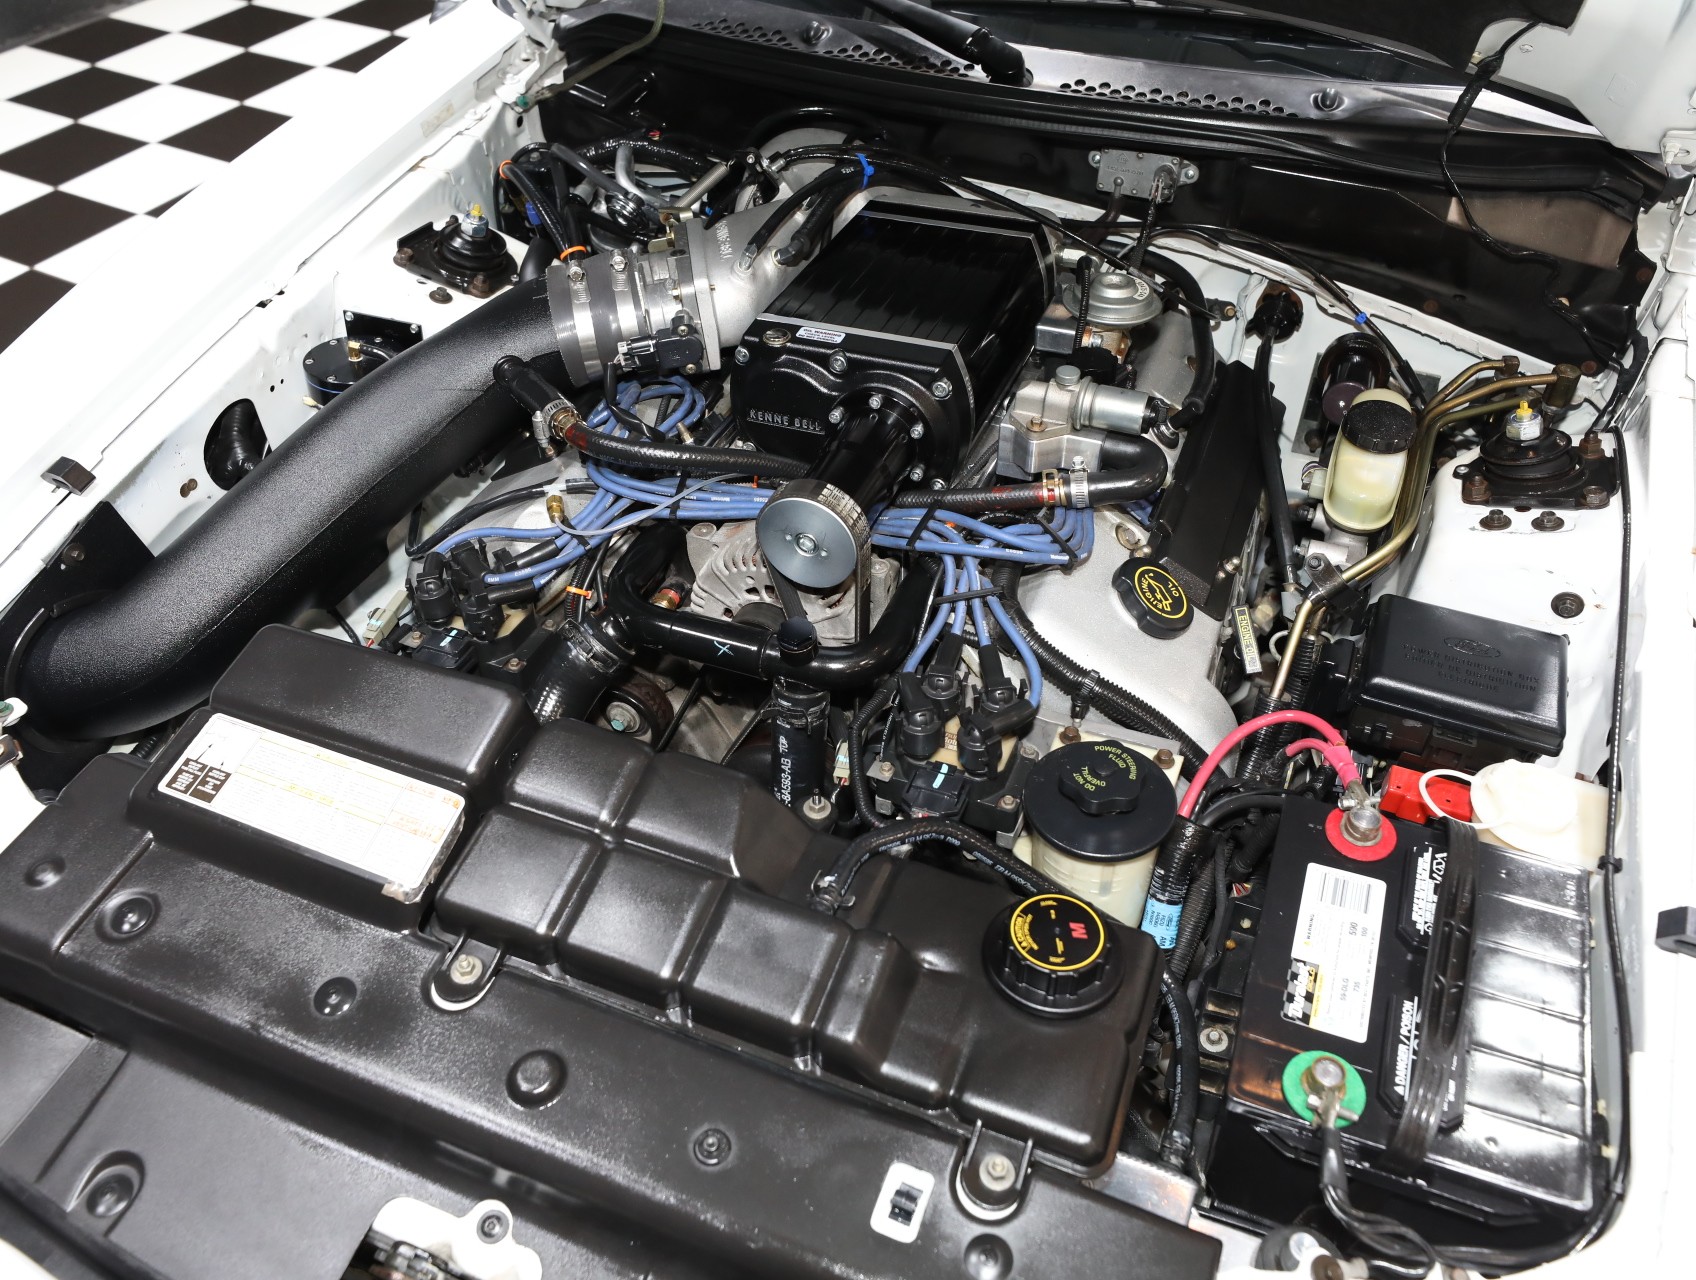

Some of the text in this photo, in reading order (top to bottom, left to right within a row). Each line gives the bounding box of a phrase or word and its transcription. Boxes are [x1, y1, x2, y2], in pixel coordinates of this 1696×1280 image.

[750, 410, 822, 431] KENNE BELL
[1167, 581, 1180, 597] OIL
[1239, 615, 1255, 660] ENGINE OIL
[779, 735, 789, 754] TOP
[1094, 745, 1137, 780] POWER STEERING
[1108, 753, 1126, 769] FLUID
[1073, 772, 1096, 791] DO NOT
[1081, 766, 1106, 787] OVERFILL
[1306, 914, 1315, 940] WARNING
[1348, 921, 1359, 936] 590
[1361, 927, 1369, 937] 100
[1288, 962, 1310, 1018] Duralast
[1400, 1000, 1414, 1036] POISON
[1395, 1043, 1409, 1086] DANGER
